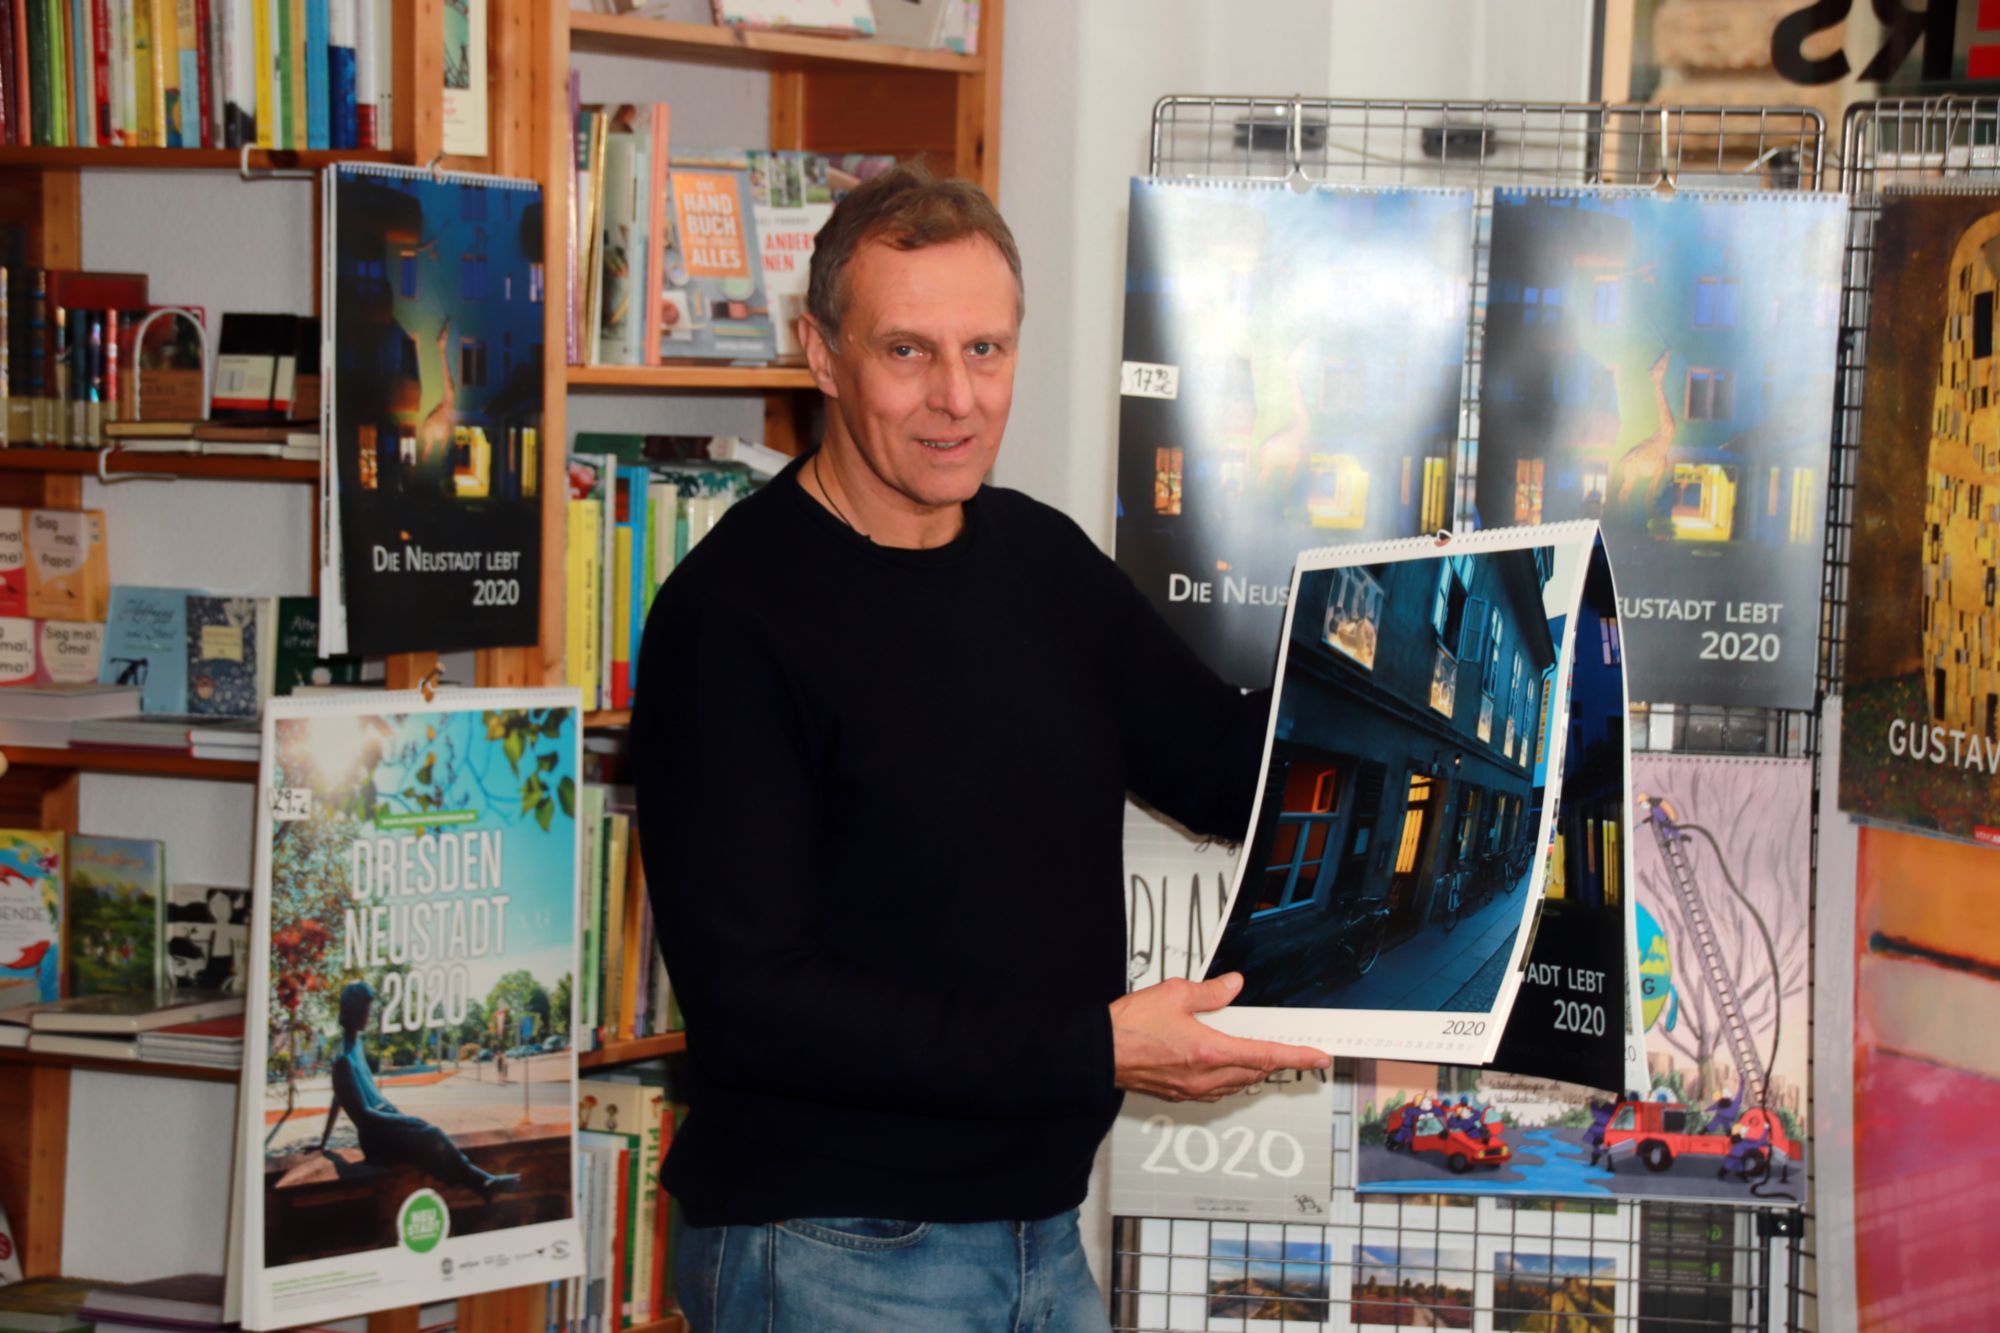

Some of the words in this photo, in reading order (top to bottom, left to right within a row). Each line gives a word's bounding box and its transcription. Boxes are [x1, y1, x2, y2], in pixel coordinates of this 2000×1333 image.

[684, 193, 733, 214] HAND
[688, 213, 737, 236] BUCH
[691, 246, 742, 270] ALLES
[472, 579, 520, 606] 2020
[1699, 630, 1781, 662] 2020
[352, 830, 503, 900] DRESDEN
[343, 896, 511, 970] NEUSTADT
[381, 963, 470, 1034] 2020
[1442, 1019, 1486, 1037] 2020
[1553, 999, 1606, 1037] 2020
[1140, 1113, 1305, 1179] 2020
